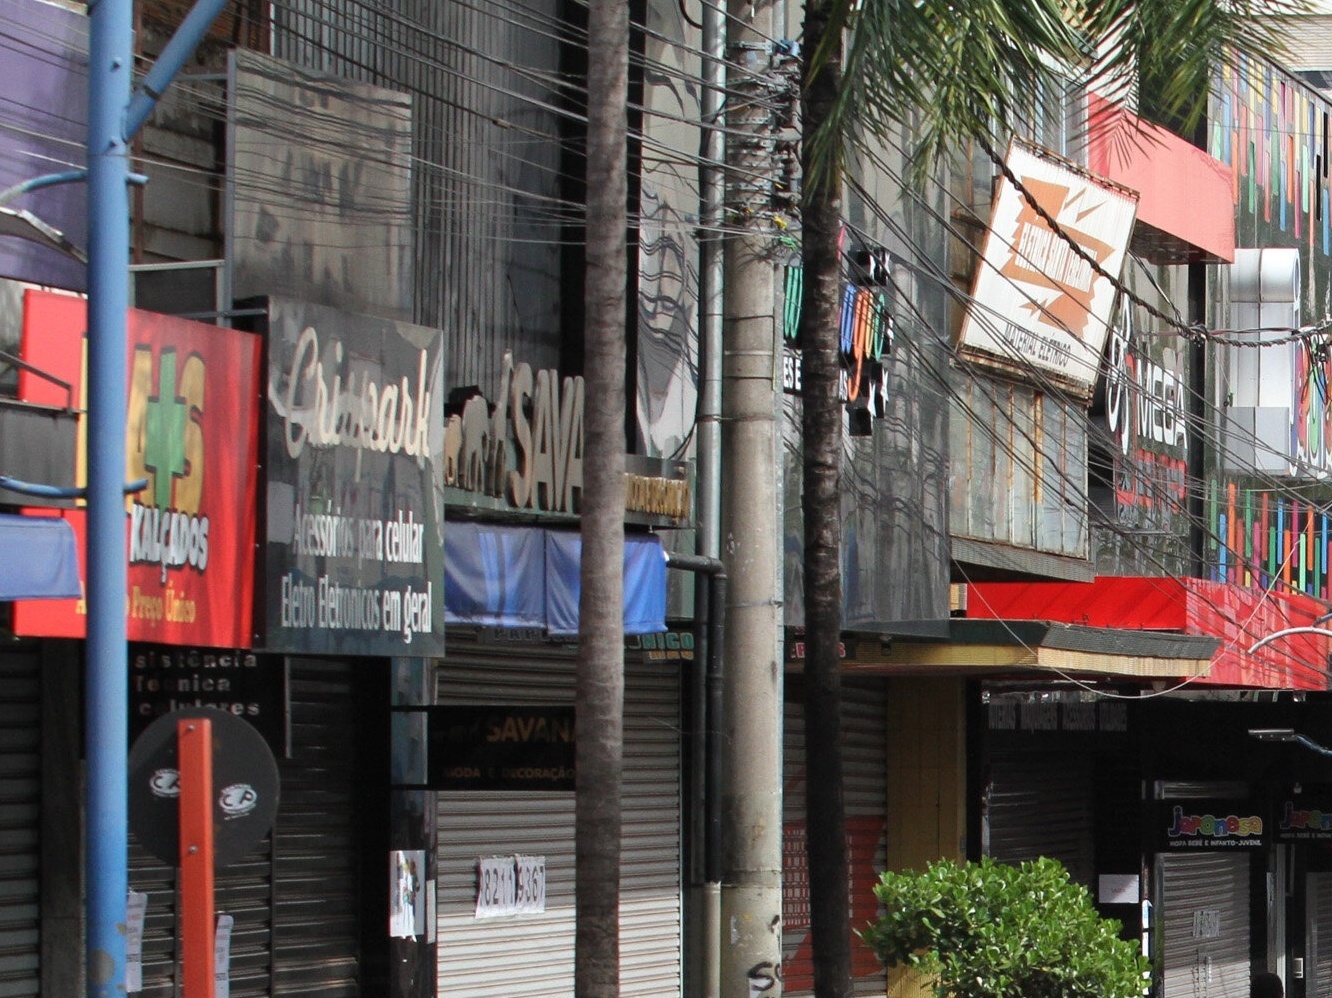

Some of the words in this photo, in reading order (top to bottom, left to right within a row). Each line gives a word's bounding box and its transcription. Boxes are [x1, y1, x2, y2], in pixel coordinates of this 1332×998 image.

[508, 362, 584, 509] SAVA
[1137, 357, 1188, 450] MEGA
[130, 503, 209, 586] KALÇADOS
[293, 499, 354, 557] Acessórios
[357, 517, 384, 569] para
[385, 509, 424, 563] celular
[165, 581, 197, 622] Único
[281, 572, 315, 628] Eletro
[382, 589, 401, 631] em
[403, 581, 432, 644] geral
[135, 650, 258, 668] sistência
[486, 721, 575, 743] SAVAN
